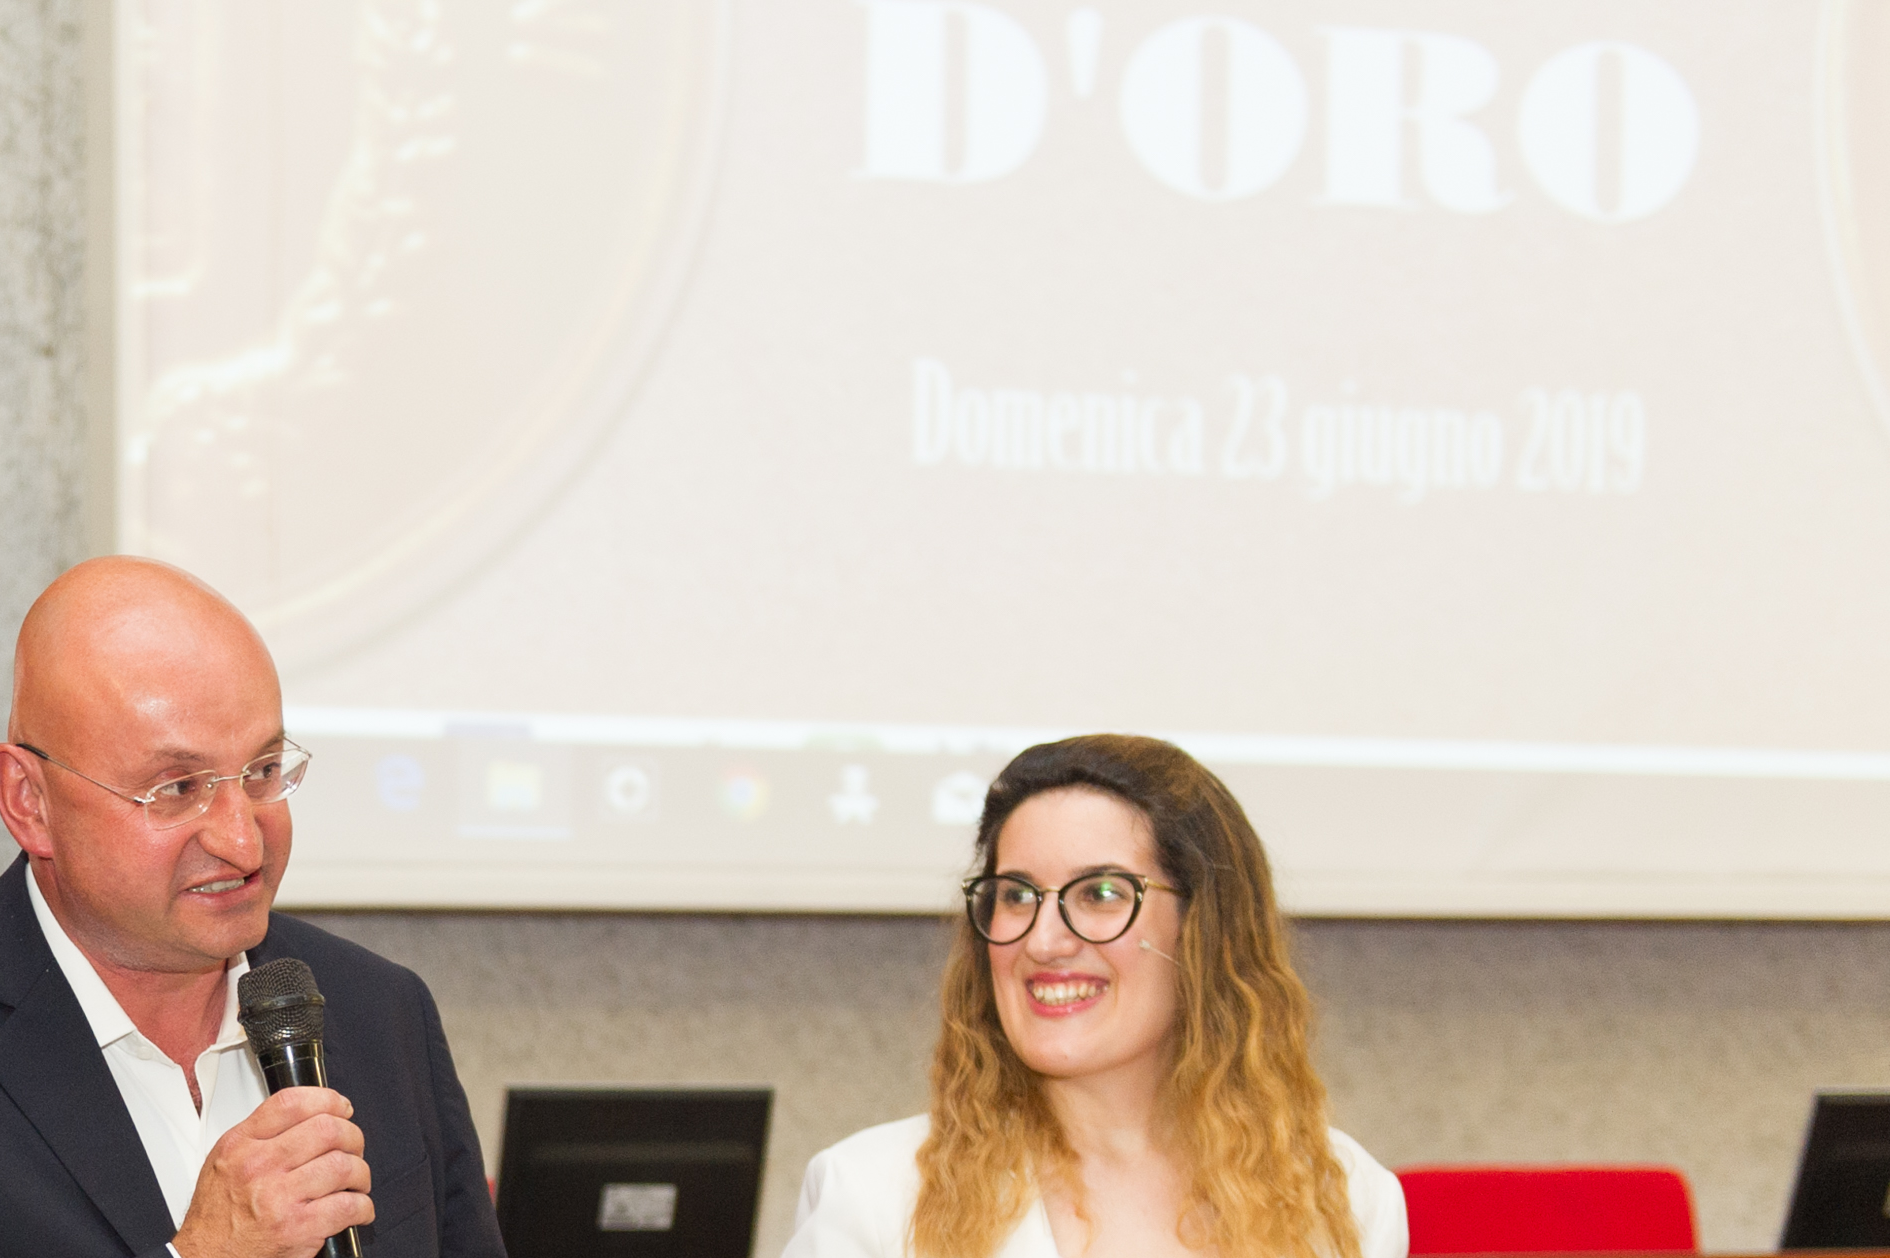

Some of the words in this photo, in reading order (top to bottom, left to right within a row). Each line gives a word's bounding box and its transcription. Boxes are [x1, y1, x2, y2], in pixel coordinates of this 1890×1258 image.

[848, 0, 1702, 224] D'ORO
[913, 357, 1206, 478] Domenica
[1220, 373, 1289, 483] 23
[1302, 380, 1504, 505] giugno
[1516, 387, 1647, 497] 2019
